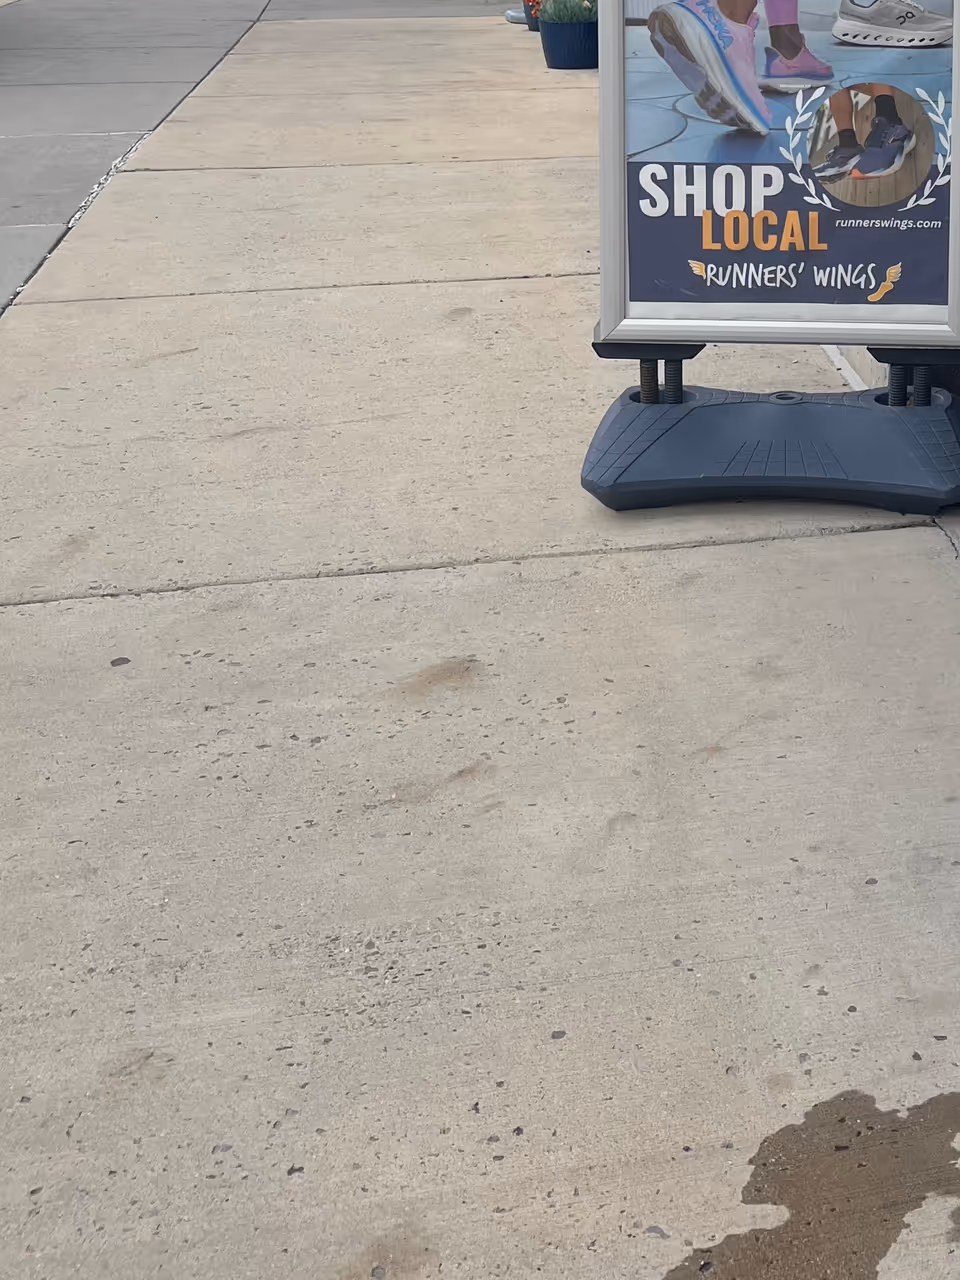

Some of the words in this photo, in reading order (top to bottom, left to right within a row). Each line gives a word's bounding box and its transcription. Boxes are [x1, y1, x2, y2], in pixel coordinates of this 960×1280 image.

[638, 163, 784, 218] SHOP
[702, 209, 828, 251] LOCAL
[835, 218, 942, 230] runnerswings.com
[706, 262, 805, 289] RUNNERS'
[813, 263, 877, 290] WINGS
